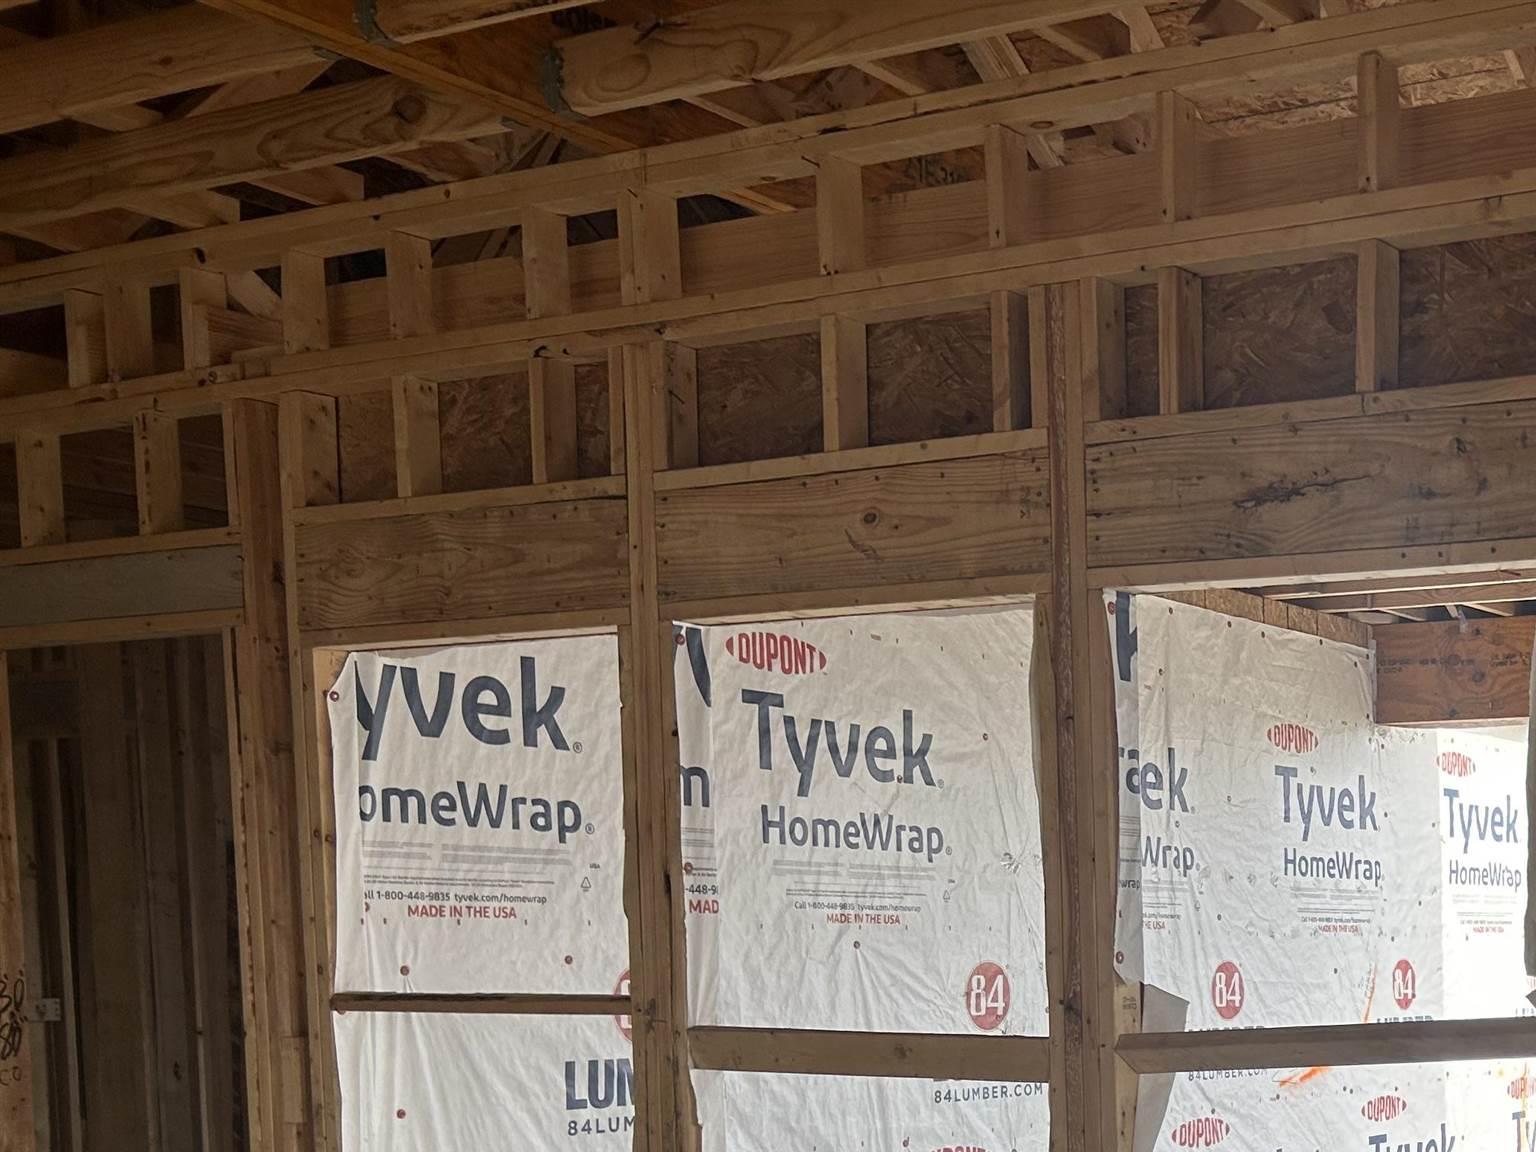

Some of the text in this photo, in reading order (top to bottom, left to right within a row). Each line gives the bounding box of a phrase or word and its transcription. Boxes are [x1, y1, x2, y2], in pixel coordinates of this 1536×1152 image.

[737, 632, 816, 675] DUPONT
[741, 688, 937, 798] Tyvek
[1273, 723, 1315, 755] DUPONT
[1441, 752, 1473, 777] DUPONT
[1274, 764, 1379, 842] Tyvek
[761, 804, 944, 863] HomeWrap
[1443, 787, 1519, 854] Tyvek
[1284, 847, 1383, 887] HomeWrap
[1448, 859, 1522, 888] HomeWrap
[377, 890, 451, 902] 1-800-448-9835
[454, 892, 547, 904] tyvek.com/homewrap
[408, 904, 518, 919] MADE IN THE USA
[827, 913, 901, 925] MADE IN THE USA
[1153, 920, 1166, 930] USA
[969, 974, 1006, 1017] 84
[1215, 972, 1241, 1008] 84
[1393, 968, 1415, 1000] 84
[933, 1082, 1044, 1104] 84LUMBER.COM
[1366, 1095, 1402, 1123] DUPONT
[1178, 1117, 1225, 1148] DUPONT
